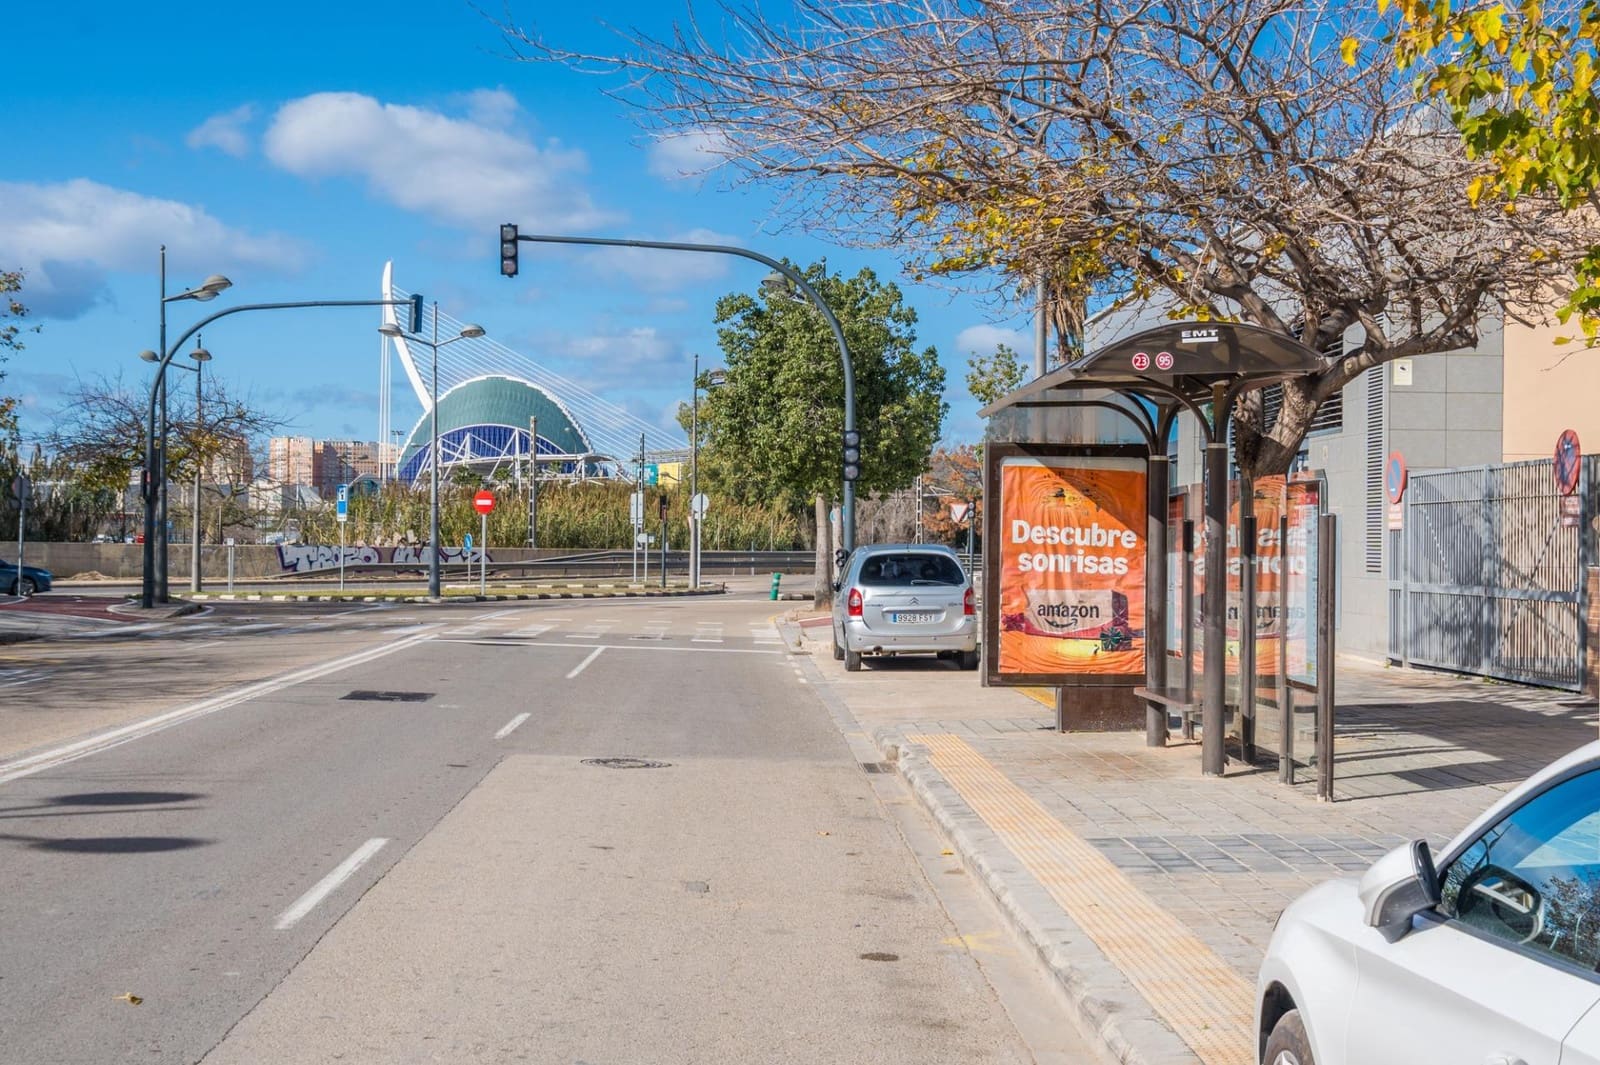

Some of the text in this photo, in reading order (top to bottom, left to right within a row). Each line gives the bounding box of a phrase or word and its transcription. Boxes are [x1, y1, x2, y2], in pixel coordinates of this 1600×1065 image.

[1181, 328, 1219, 338] EMT
[1135, 355, 1171, 366] 23 95
[1011, 519, 1137, 549] Descubre
[1018, 549, 1129, 575] sonrisas
[1037, 603, 1100, 619] amazon
[897, 614, 917, 622] 9928
